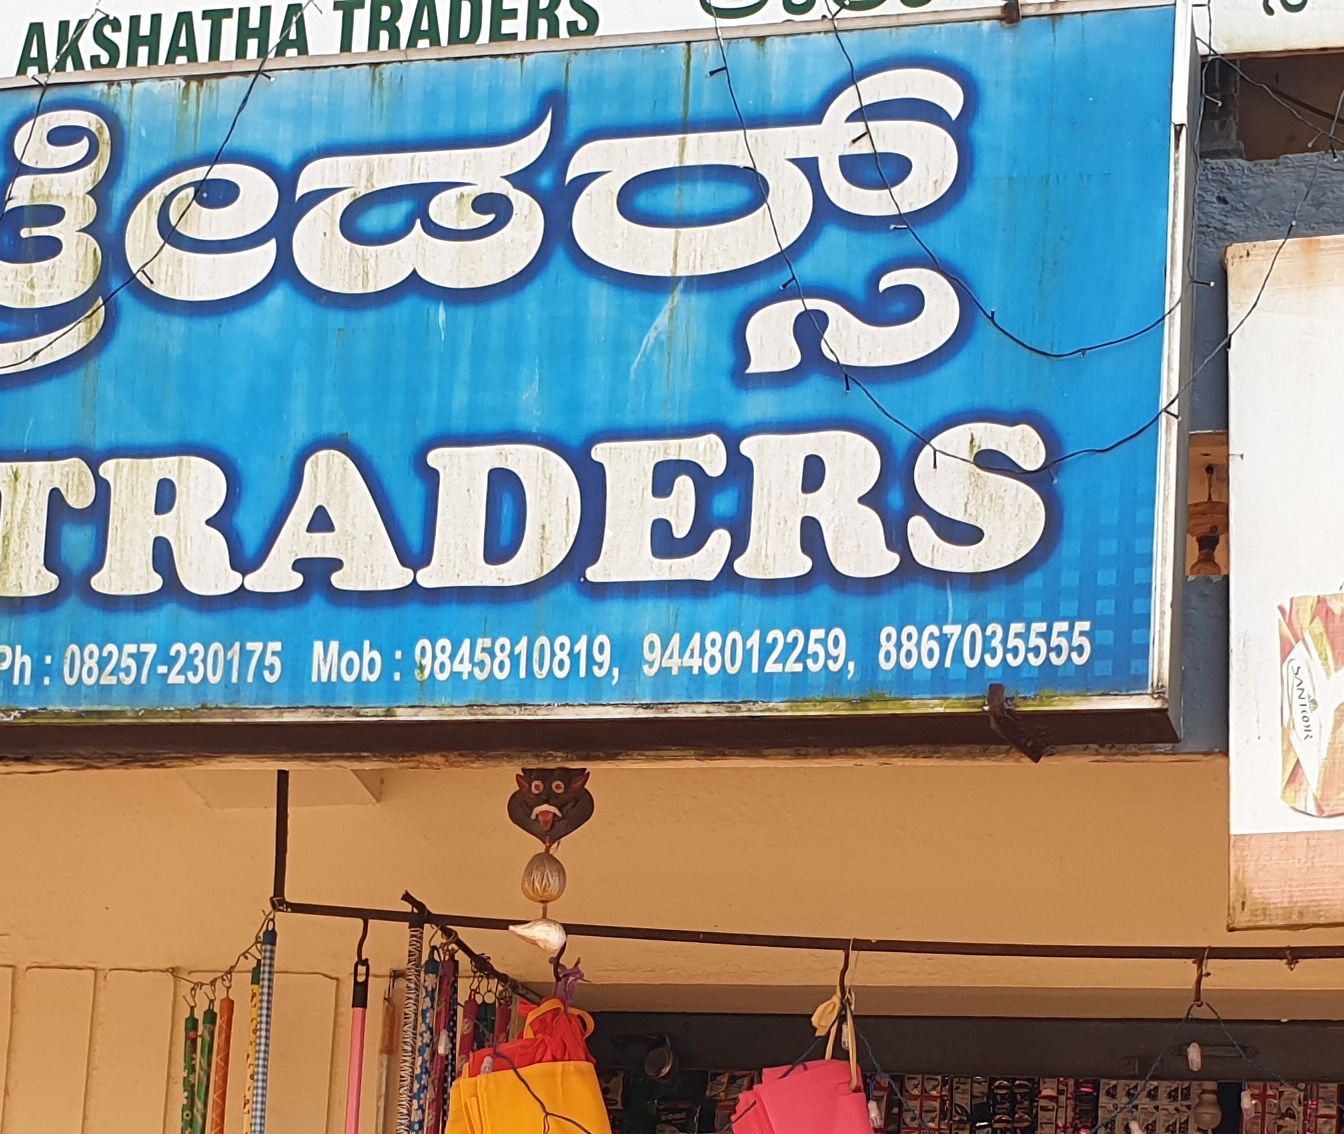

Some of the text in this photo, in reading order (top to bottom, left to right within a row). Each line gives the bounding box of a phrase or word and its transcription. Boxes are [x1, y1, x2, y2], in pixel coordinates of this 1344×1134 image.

[15, 0, 601, 77] AKSHATHA TRADERS
[63, 641, 283, 686] 08257-230175
[311, 639, 383, 684] Mob
[413, 635, 621, 686] 9845810819,
[642, 627, 856, 681] 9448012259,
[878, 620, 1092, 671] 8867035555
